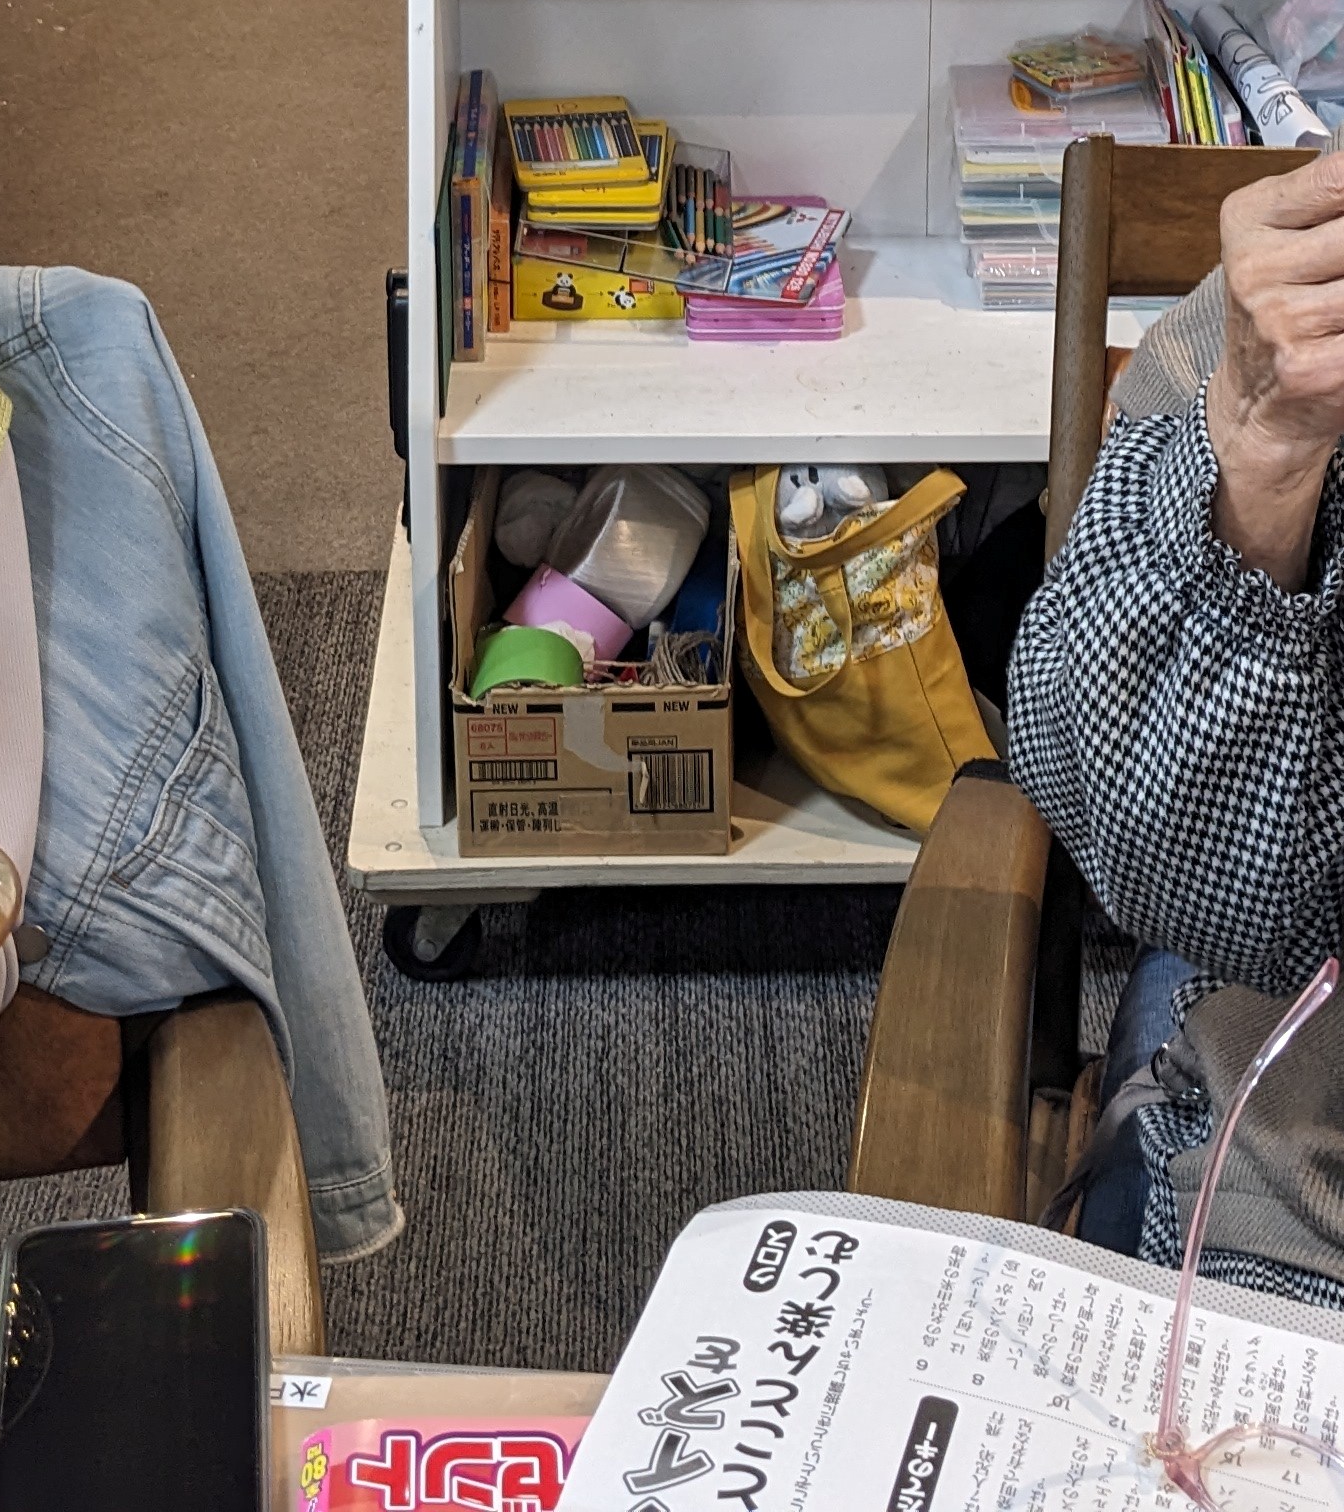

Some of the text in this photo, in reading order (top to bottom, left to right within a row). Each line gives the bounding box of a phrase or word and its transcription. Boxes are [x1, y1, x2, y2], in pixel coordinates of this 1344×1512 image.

[492, 703, 519, 715] NEW
[663, 700, 690, 712] NEW
[751, 1228, 787, 1284] クロス
[915, 1359, 929, 1372] 6
[971, 1373, 985, 1386] 8
[1108, 1415, 1130, 1432] 12
[1281, 1469, 1302, 1486] 17
